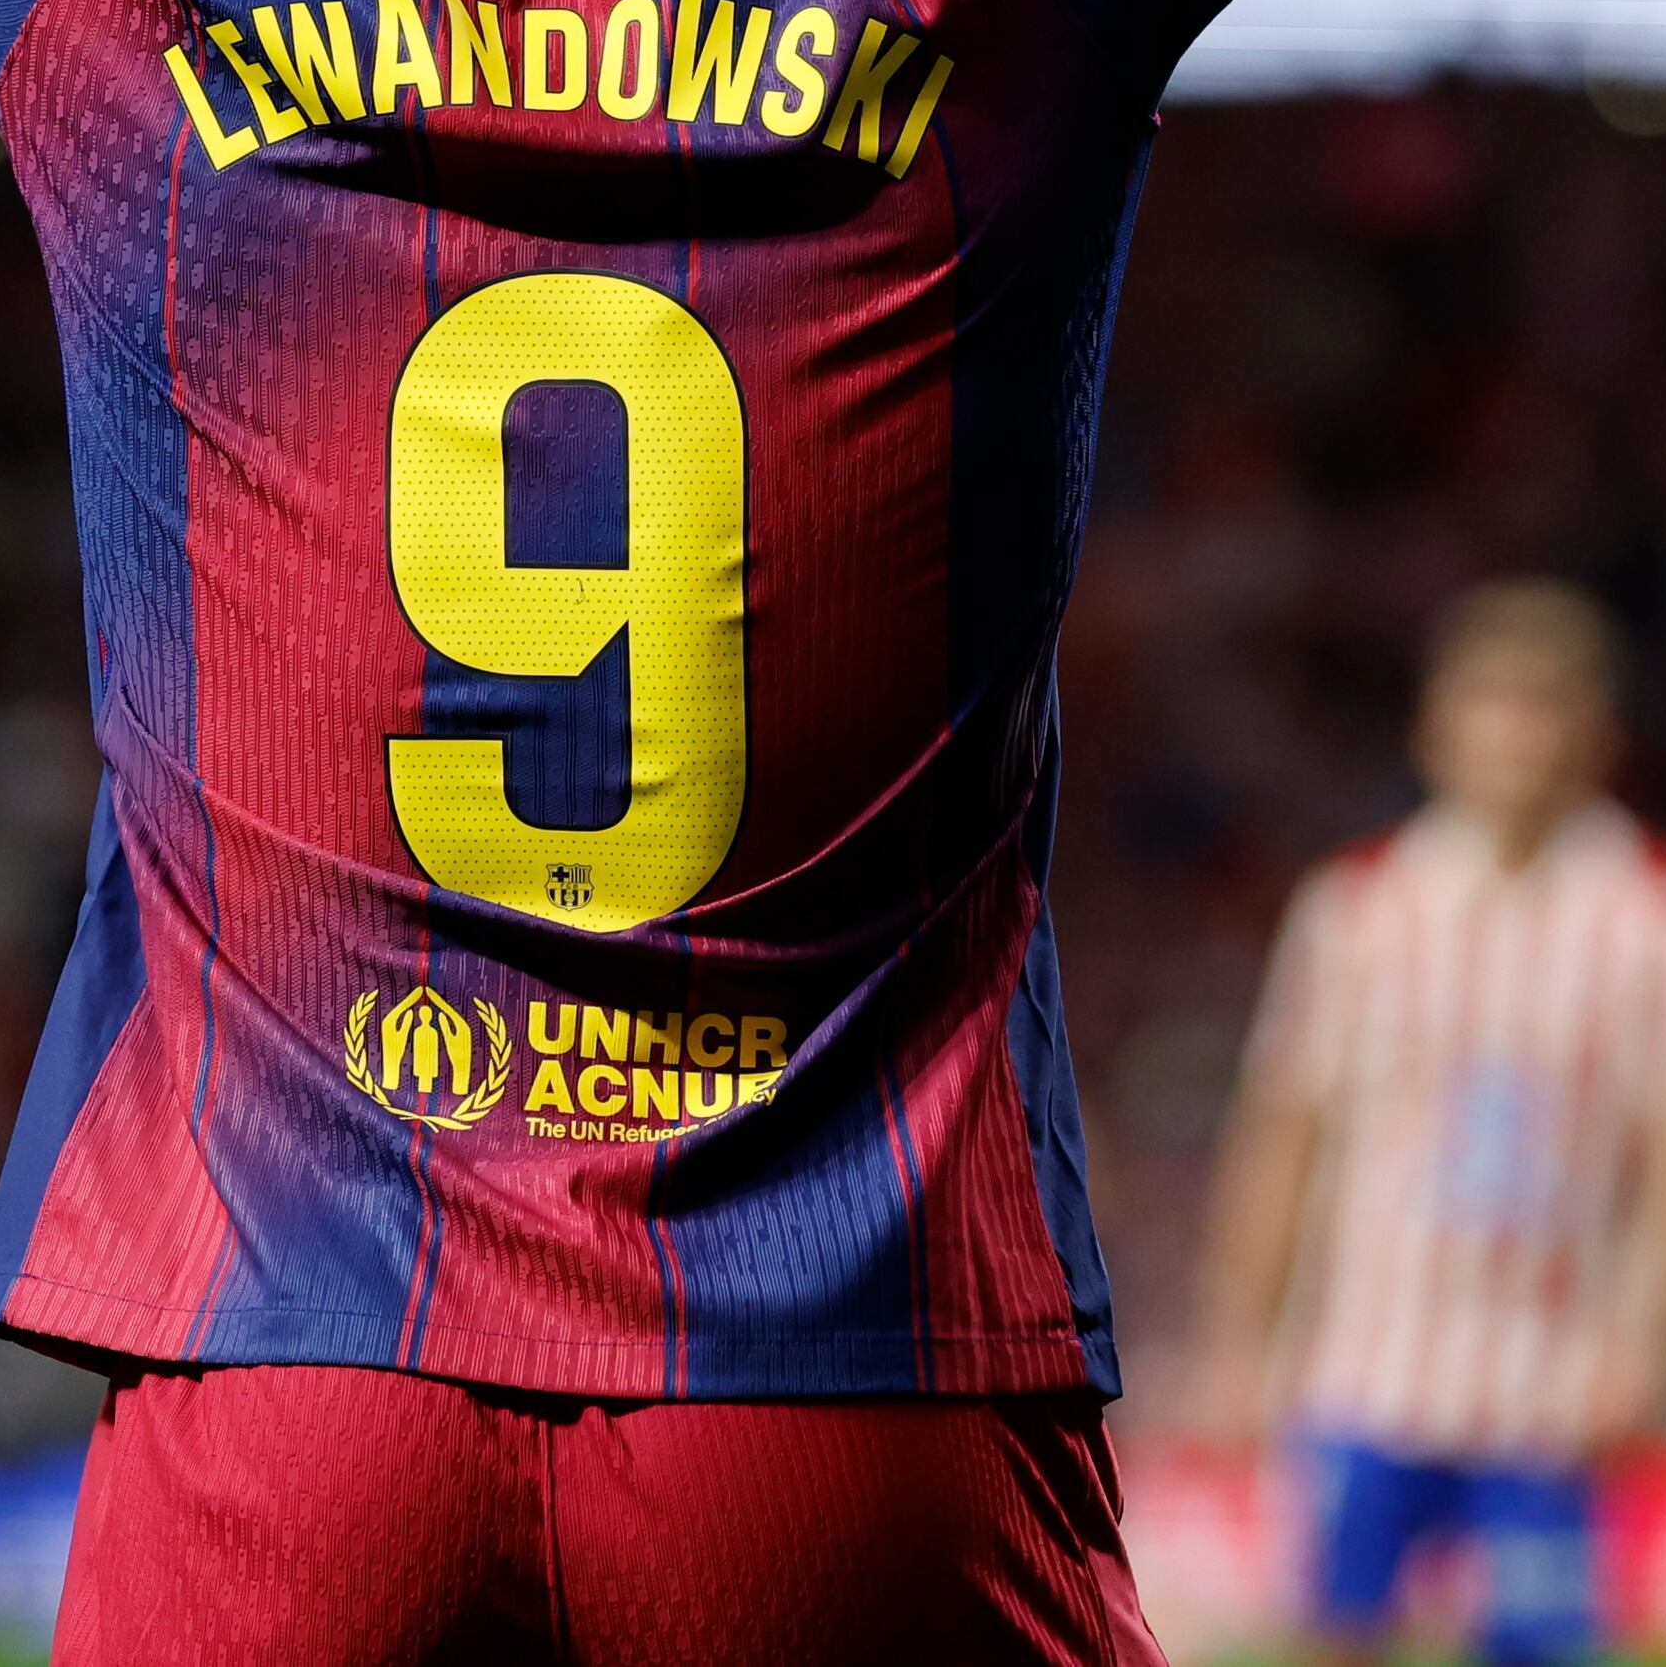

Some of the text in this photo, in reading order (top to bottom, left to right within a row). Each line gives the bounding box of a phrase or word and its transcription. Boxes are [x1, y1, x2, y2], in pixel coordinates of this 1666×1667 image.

[386, 269, 749, 934] 9
[527, 1001, 788, 1069] UNHCR
[525, 1117, 566, 1138] The
[571, 1120, 604, 1141] UN
